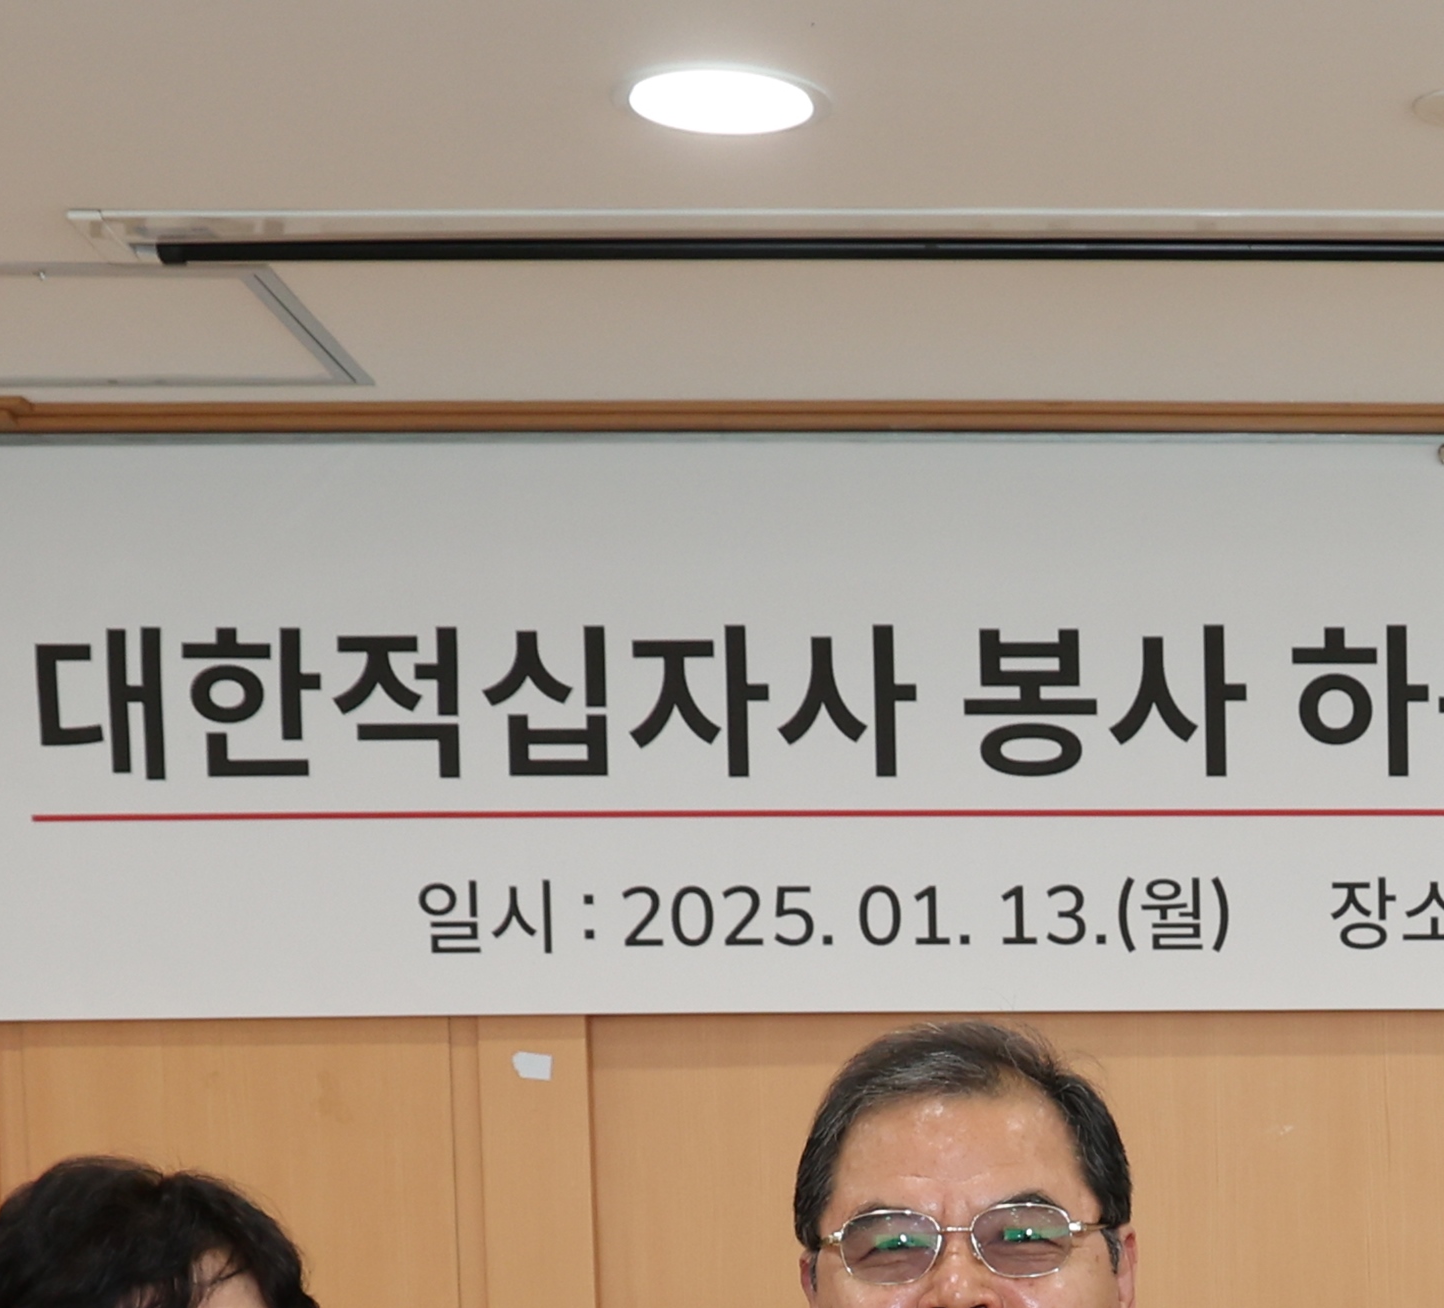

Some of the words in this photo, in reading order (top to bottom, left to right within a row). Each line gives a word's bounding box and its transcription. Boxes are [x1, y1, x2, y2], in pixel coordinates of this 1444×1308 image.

[34, 624, 919, 785] 대한적십자사
[962, 624, 1249, 785] 봉사
[417, 877, 554, 957] 일시
[621, 885, 835, 950] 2025.
[857, 883, 971, 949] 01.
[999, 878, 1231, 957] 13.(월)
